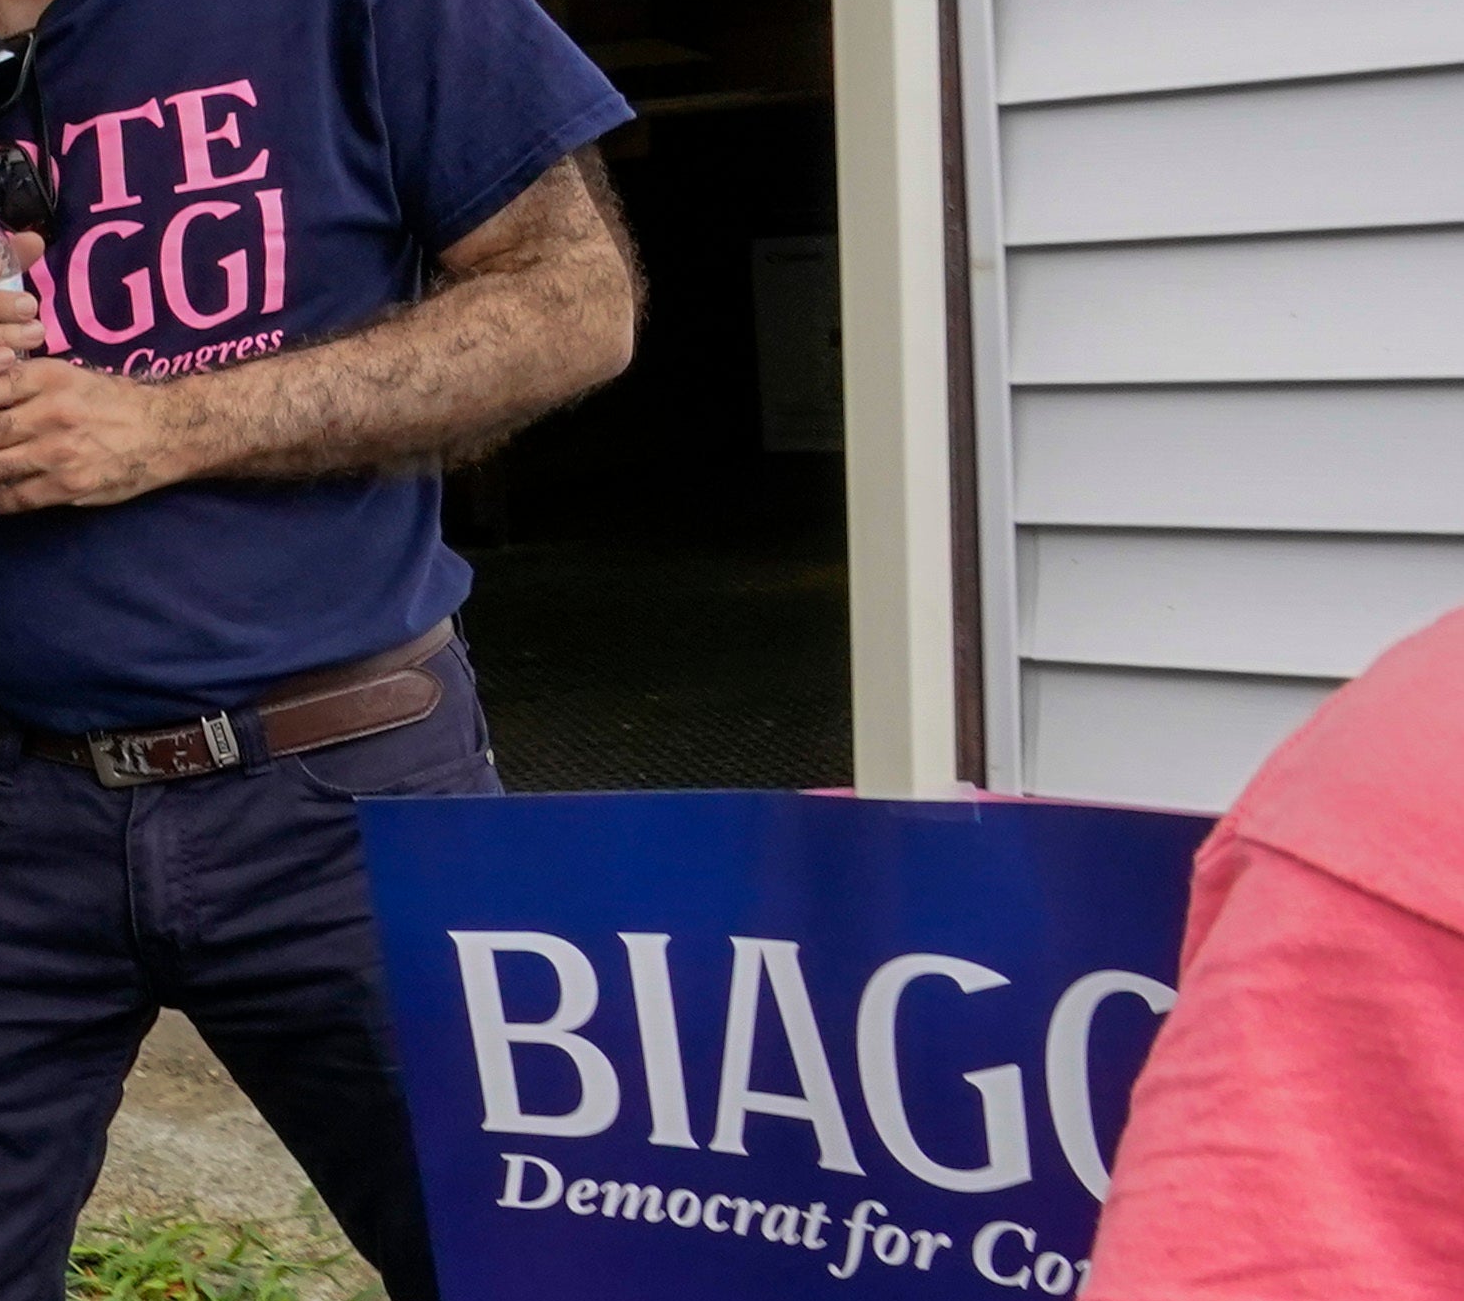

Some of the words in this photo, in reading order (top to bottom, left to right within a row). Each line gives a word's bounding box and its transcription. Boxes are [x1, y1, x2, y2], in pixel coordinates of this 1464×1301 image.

[6, 187, 286, 355] GGI
[122, 328, 285, 381] Congress
[446, 929, 1181, 1207] BIAGG
[496, 1153, 832, 1252] Democrat
[827, 1199, 954, 1280] for
